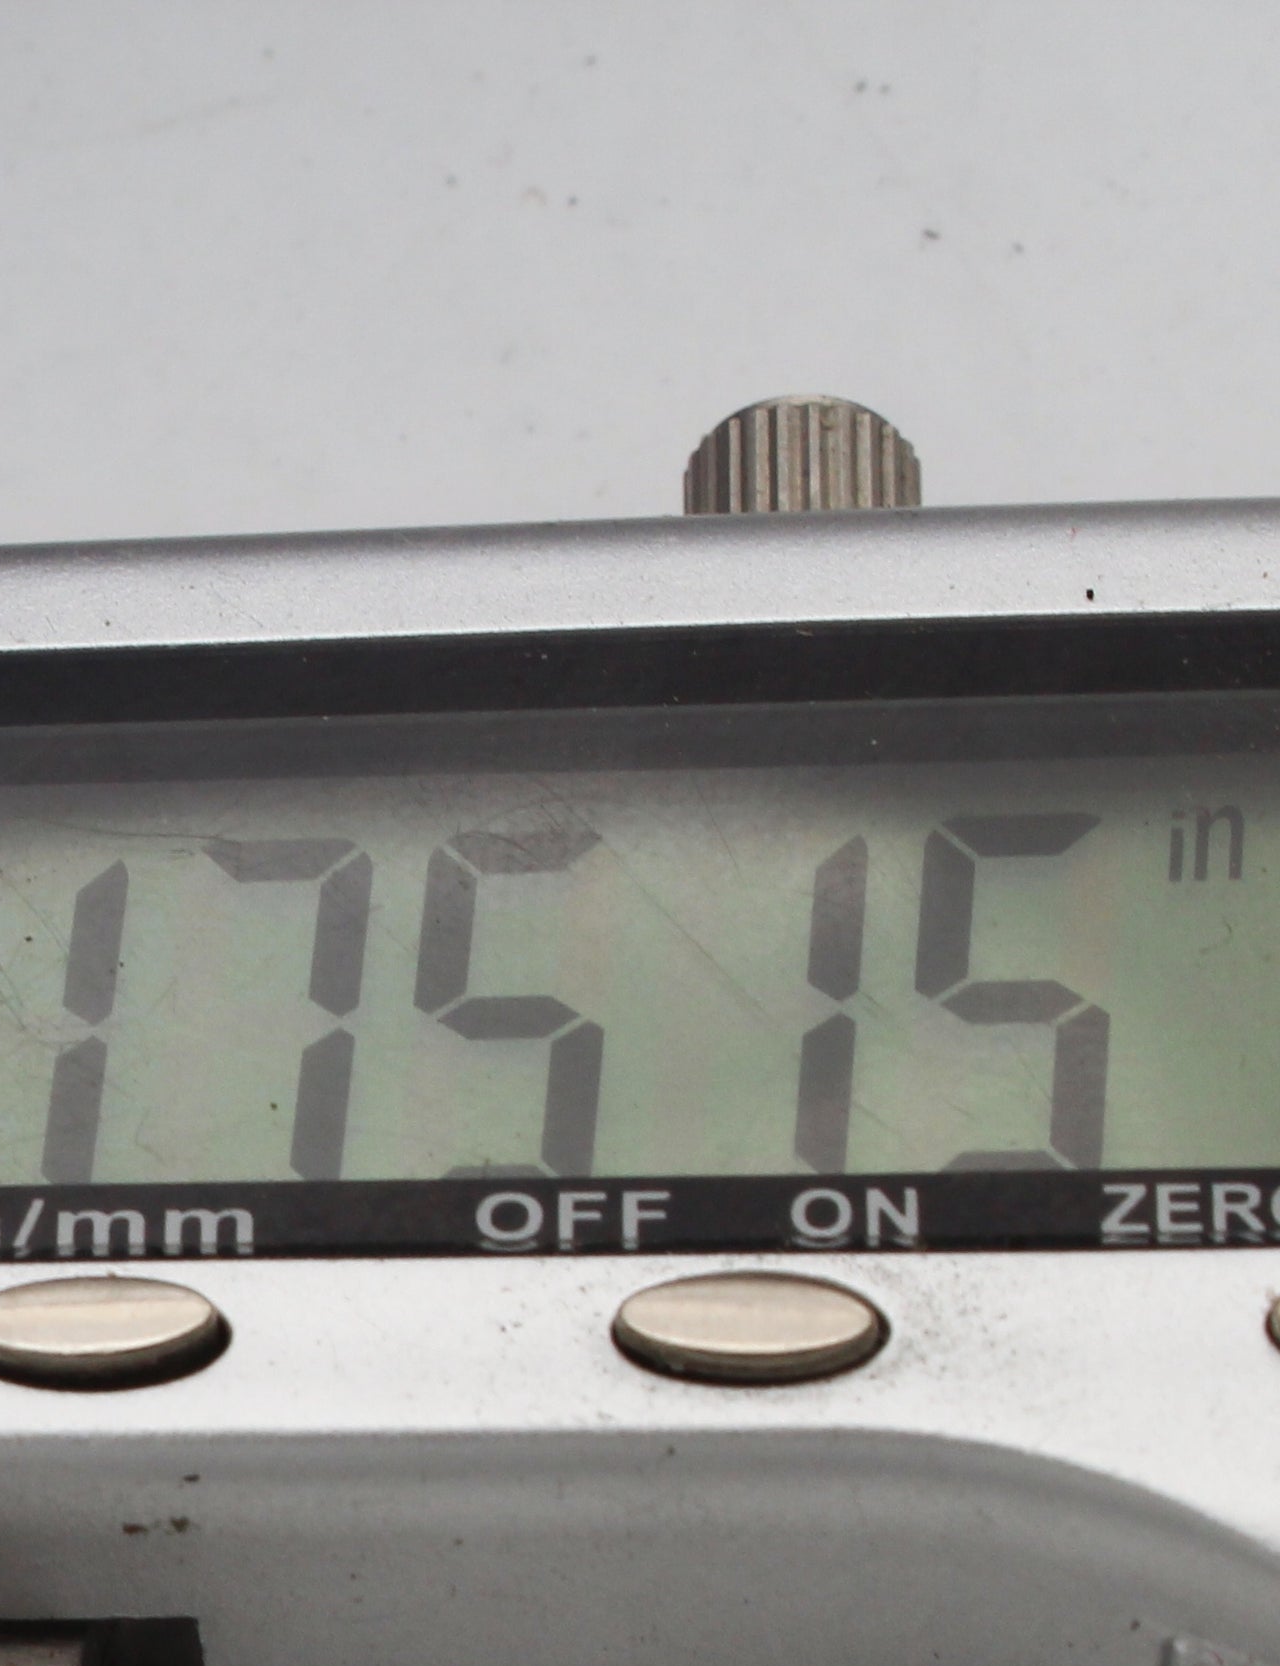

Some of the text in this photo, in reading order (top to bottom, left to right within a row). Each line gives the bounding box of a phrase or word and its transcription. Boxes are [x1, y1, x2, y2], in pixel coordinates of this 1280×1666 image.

[1168, 804, 1245, 882] in
[475, 1190, 672, 1246] OFF
[790, 1187, 922, 1244] ON
[1100, 1183, 1280, 1242] ZER
